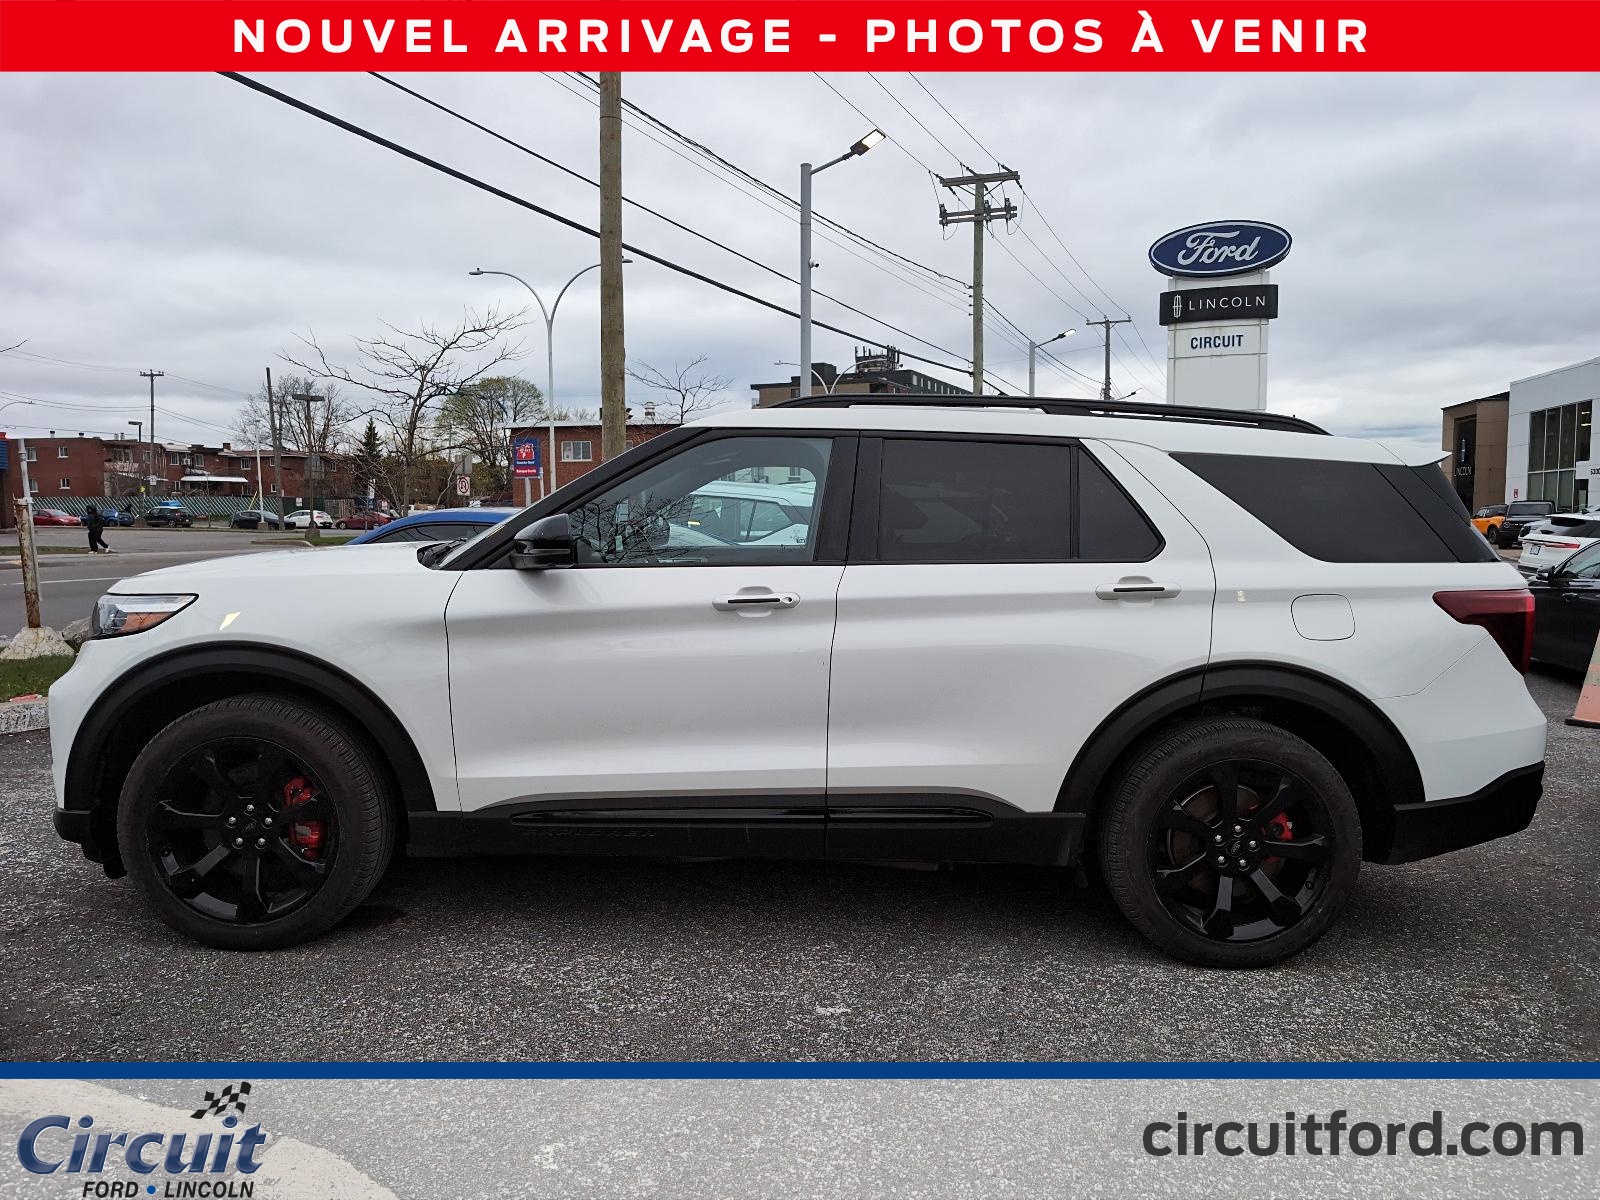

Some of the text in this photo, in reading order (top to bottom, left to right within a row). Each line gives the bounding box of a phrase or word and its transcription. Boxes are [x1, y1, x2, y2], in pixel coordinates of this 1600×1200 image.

[1177, 230, 1262, 266] Ford
[1188, 295, 1267, 311] LINCOLN
[1190, 334, 1244, 350] CIRCUIT
